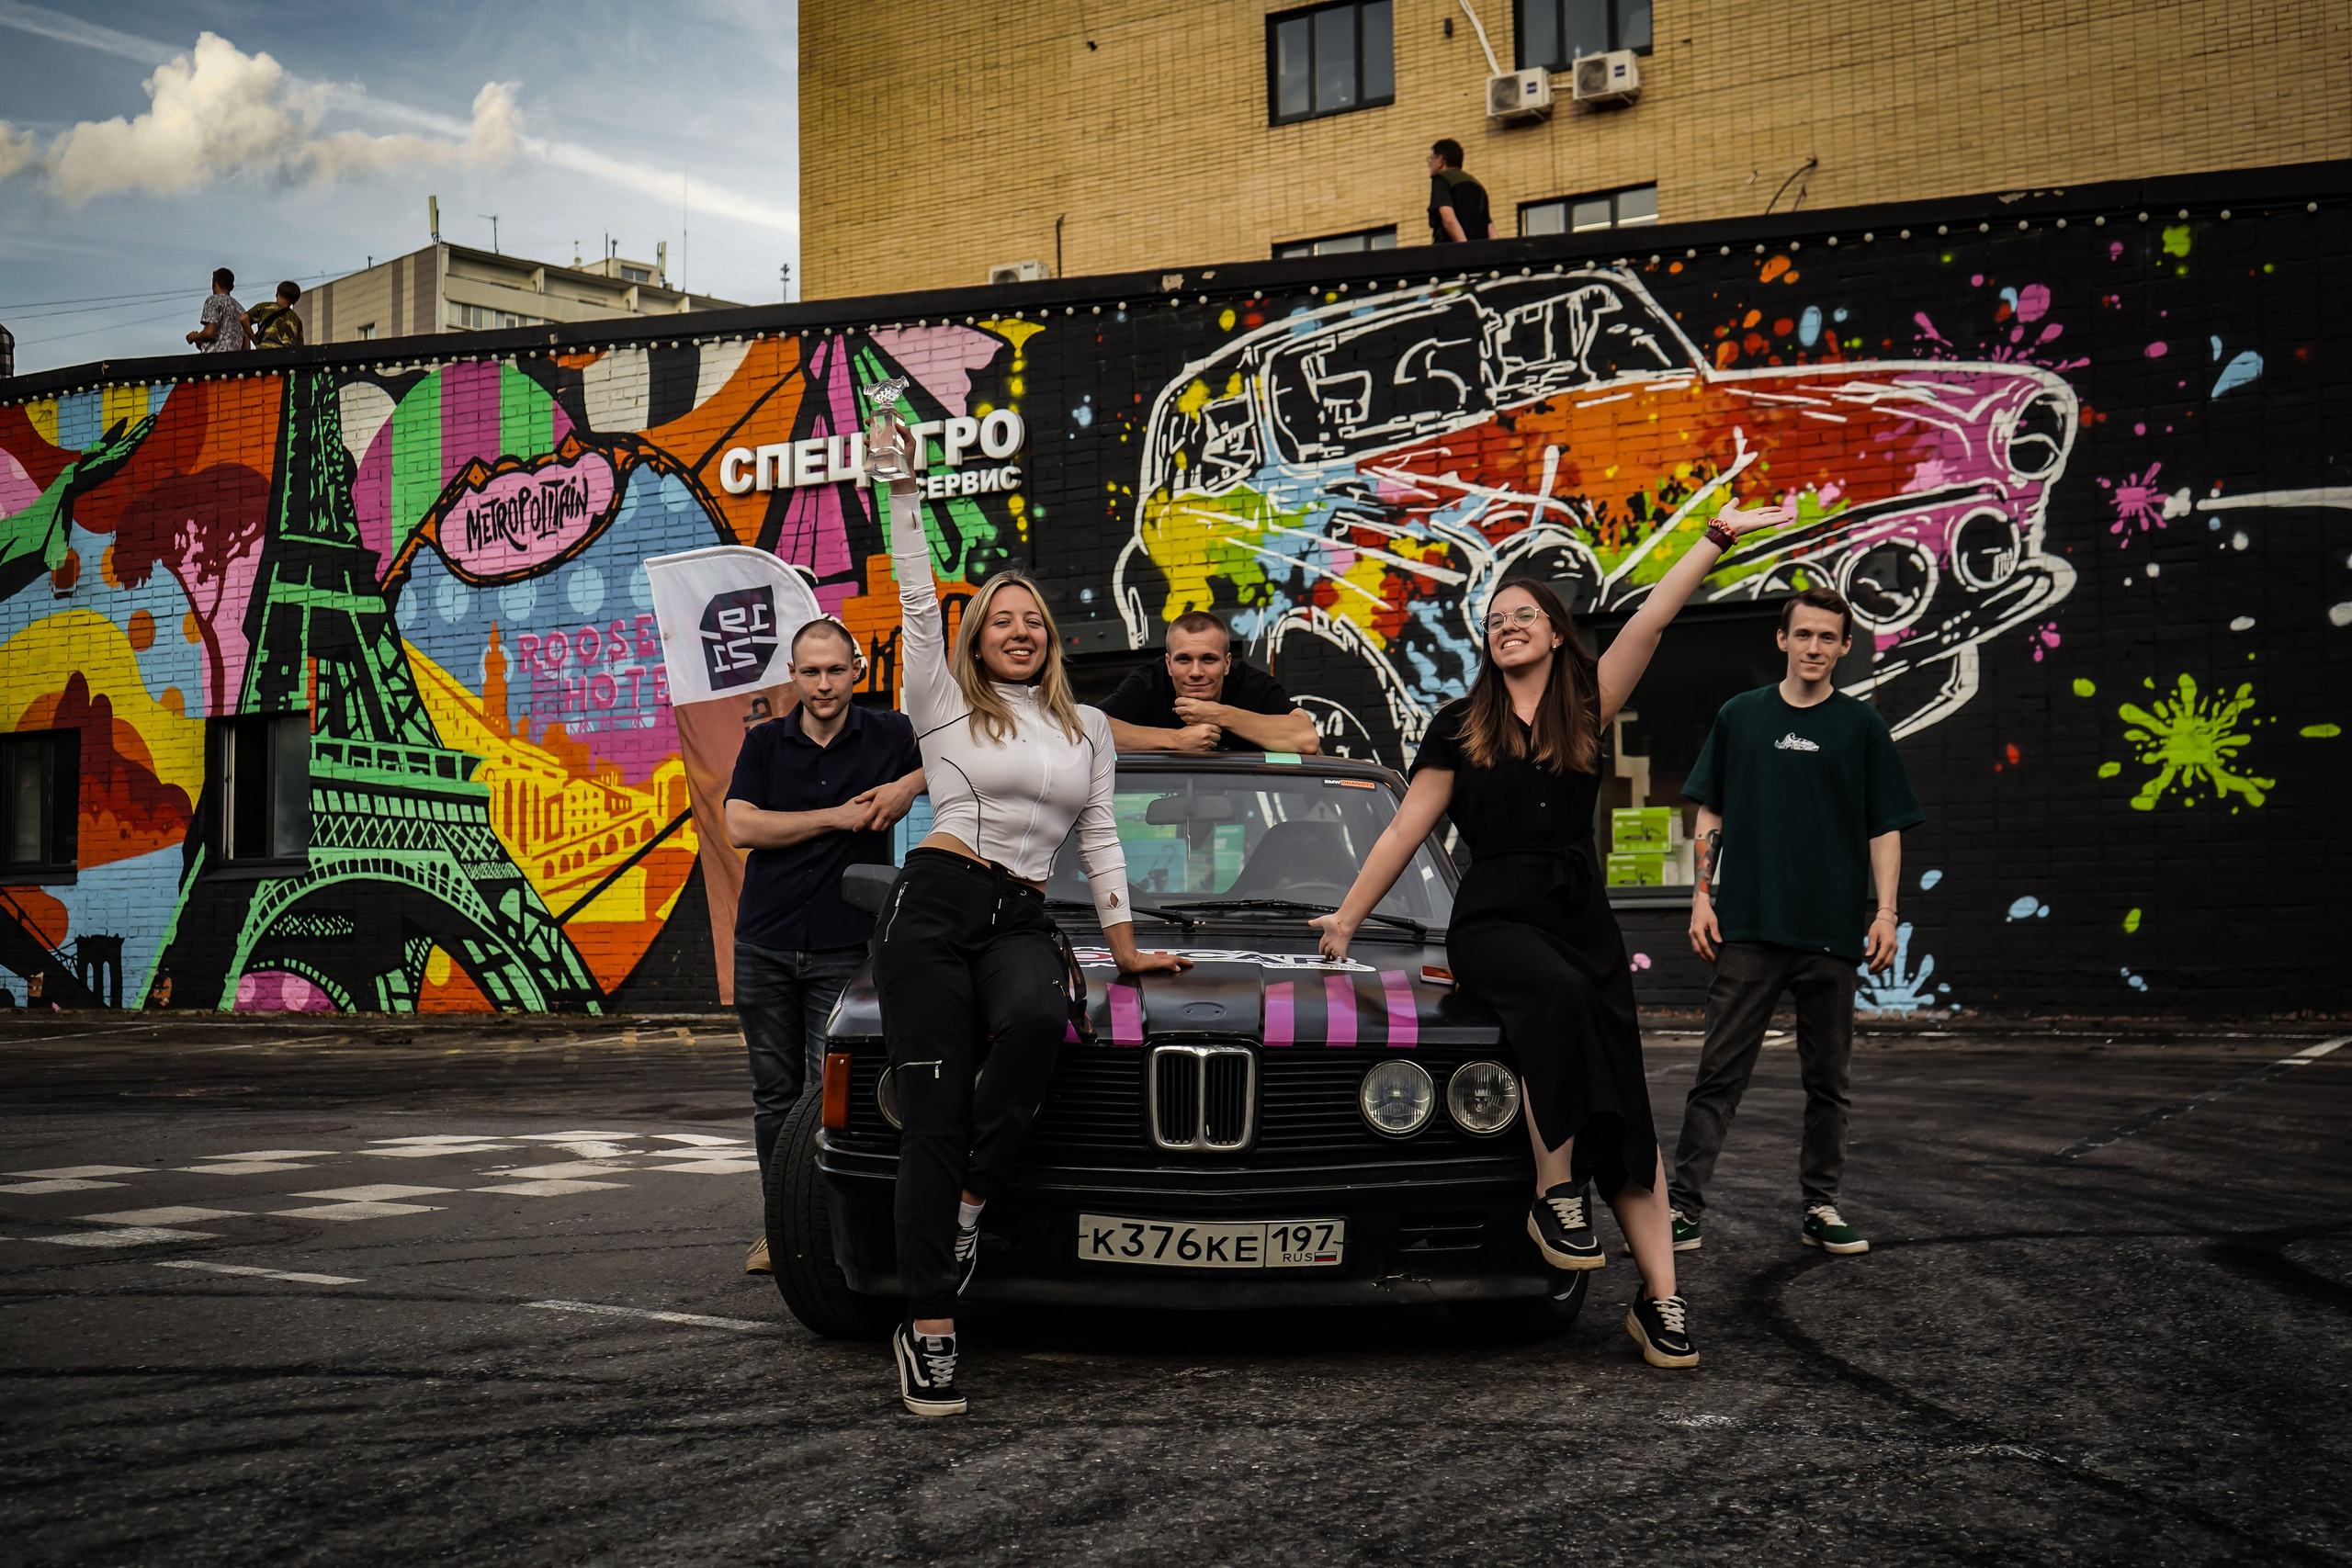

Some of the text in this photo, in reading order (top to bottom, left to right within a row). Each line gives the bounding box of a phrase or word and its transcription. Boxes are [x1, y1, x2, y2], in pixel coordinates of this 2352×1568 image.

[719, 409, 1025, 494] СПЕЦГРО
[1271, 1224, 1335, 1252] 197
[1283, 1252, 1313, 1263] RUS
